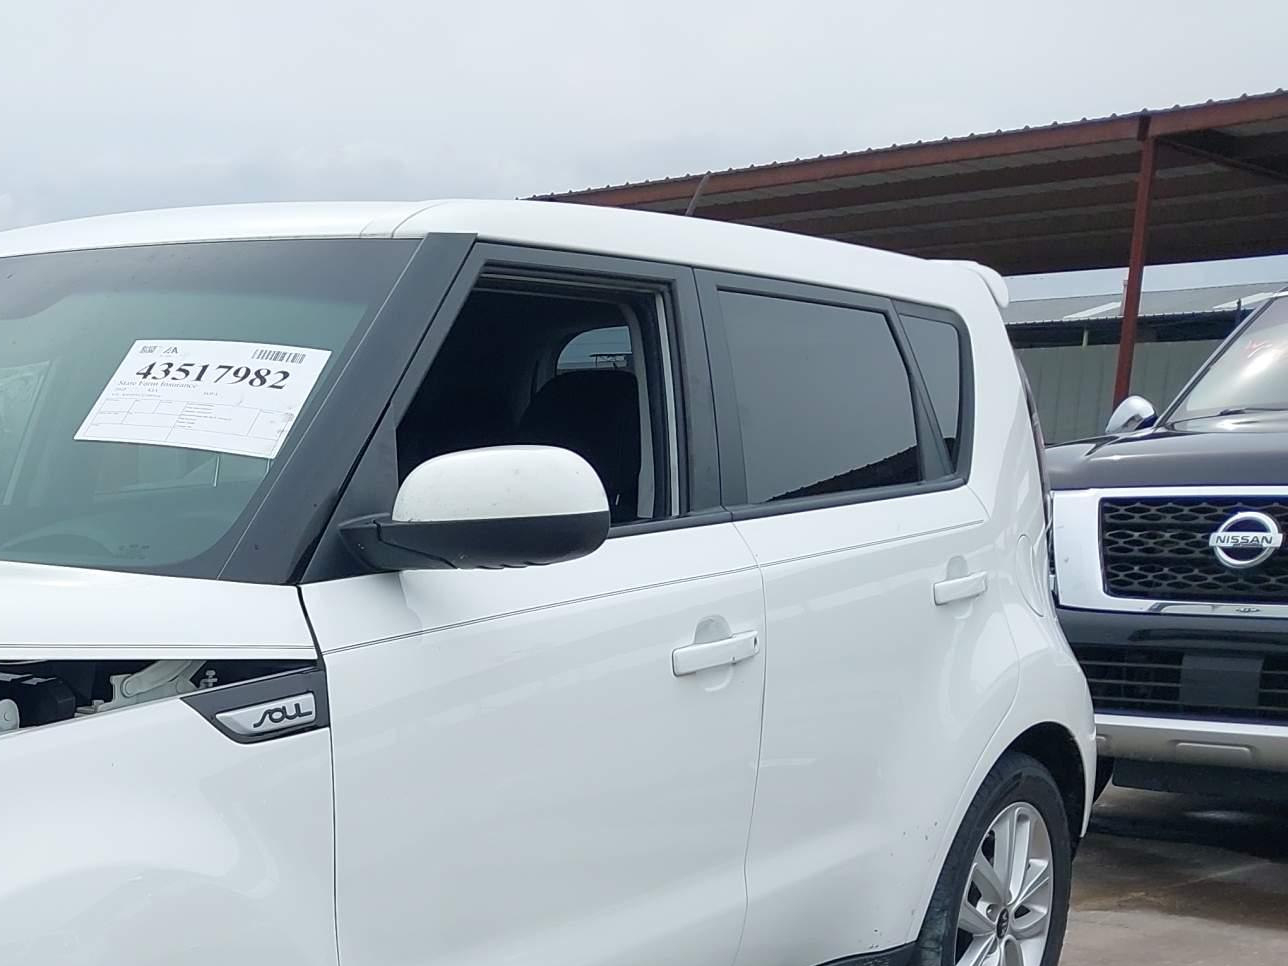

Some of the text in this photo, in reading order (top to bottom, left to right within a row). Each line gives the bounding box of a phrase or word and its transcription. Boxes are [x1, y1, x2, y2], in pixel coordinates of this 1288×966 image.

[136, 362, 289, 389] 43517982
[1215, 535, 1273, 545] NISSAN
[253, 702, 312, 729] SOUL
